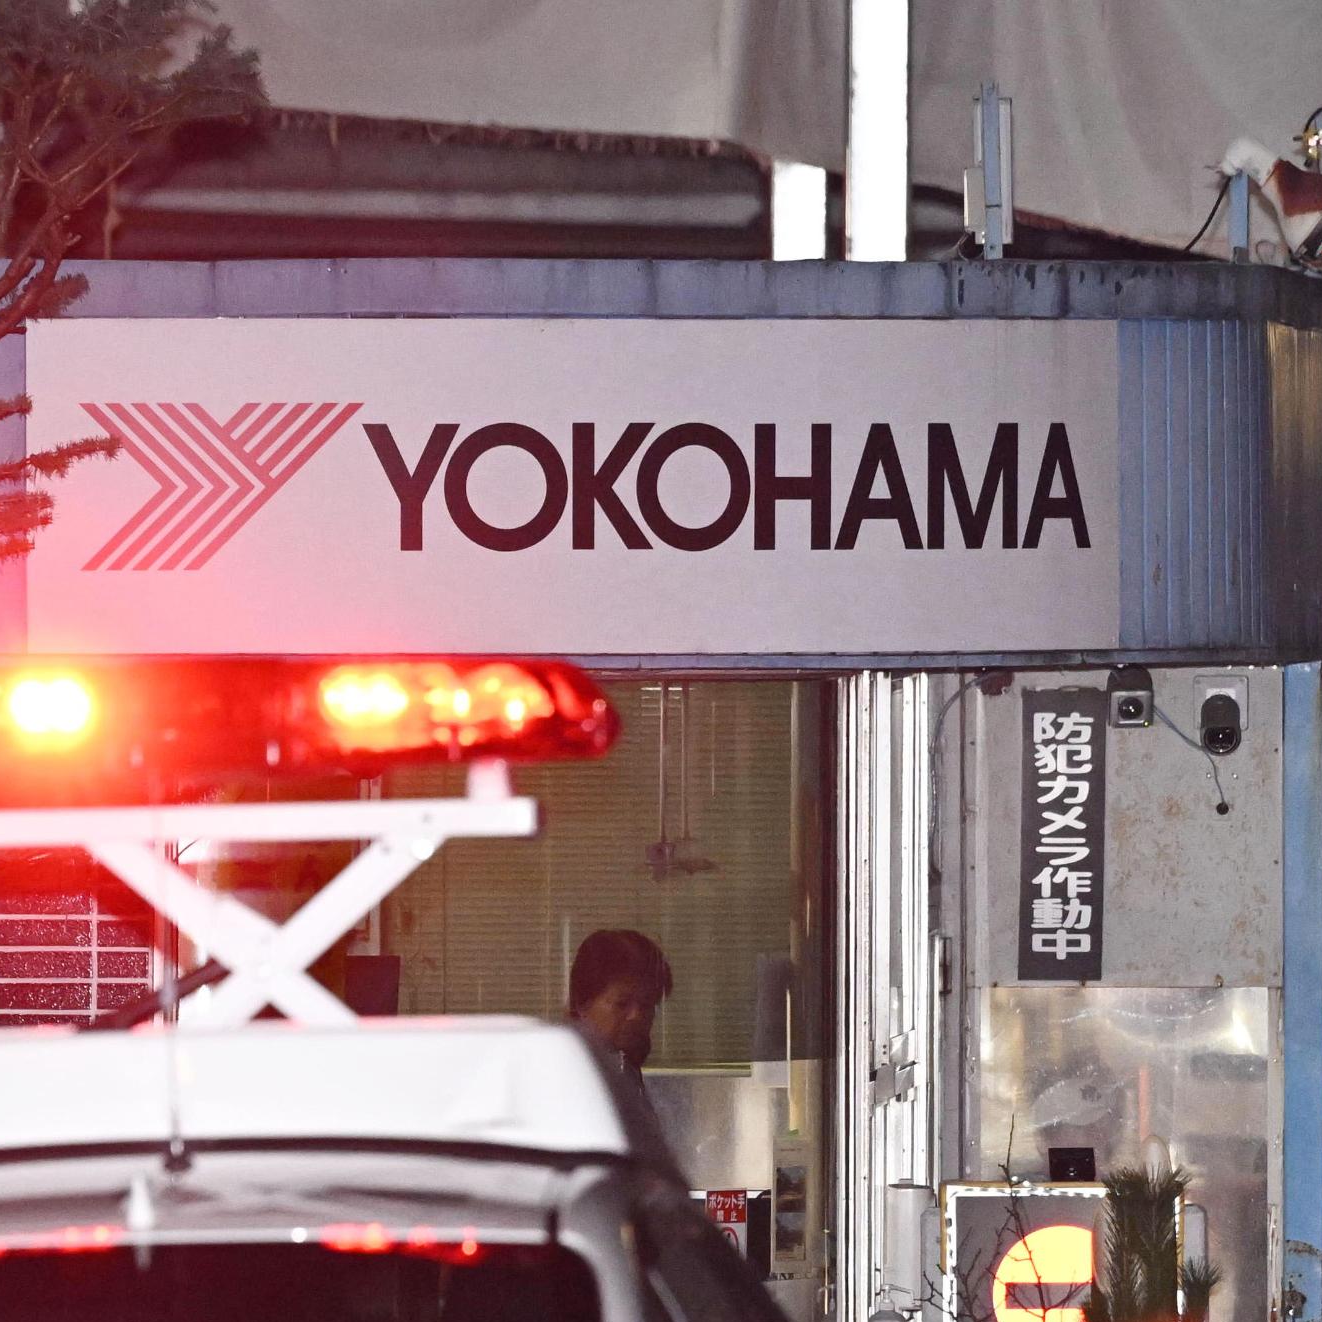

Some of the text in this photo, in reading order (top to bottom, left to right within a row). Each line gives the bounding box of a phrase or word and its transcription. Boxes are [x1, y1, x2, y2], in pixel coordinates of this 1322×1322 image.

[361, 421, 1091, 552] YOKOHAMA
[1030, 711, 1095, 961] 防犯カメラ作動中
